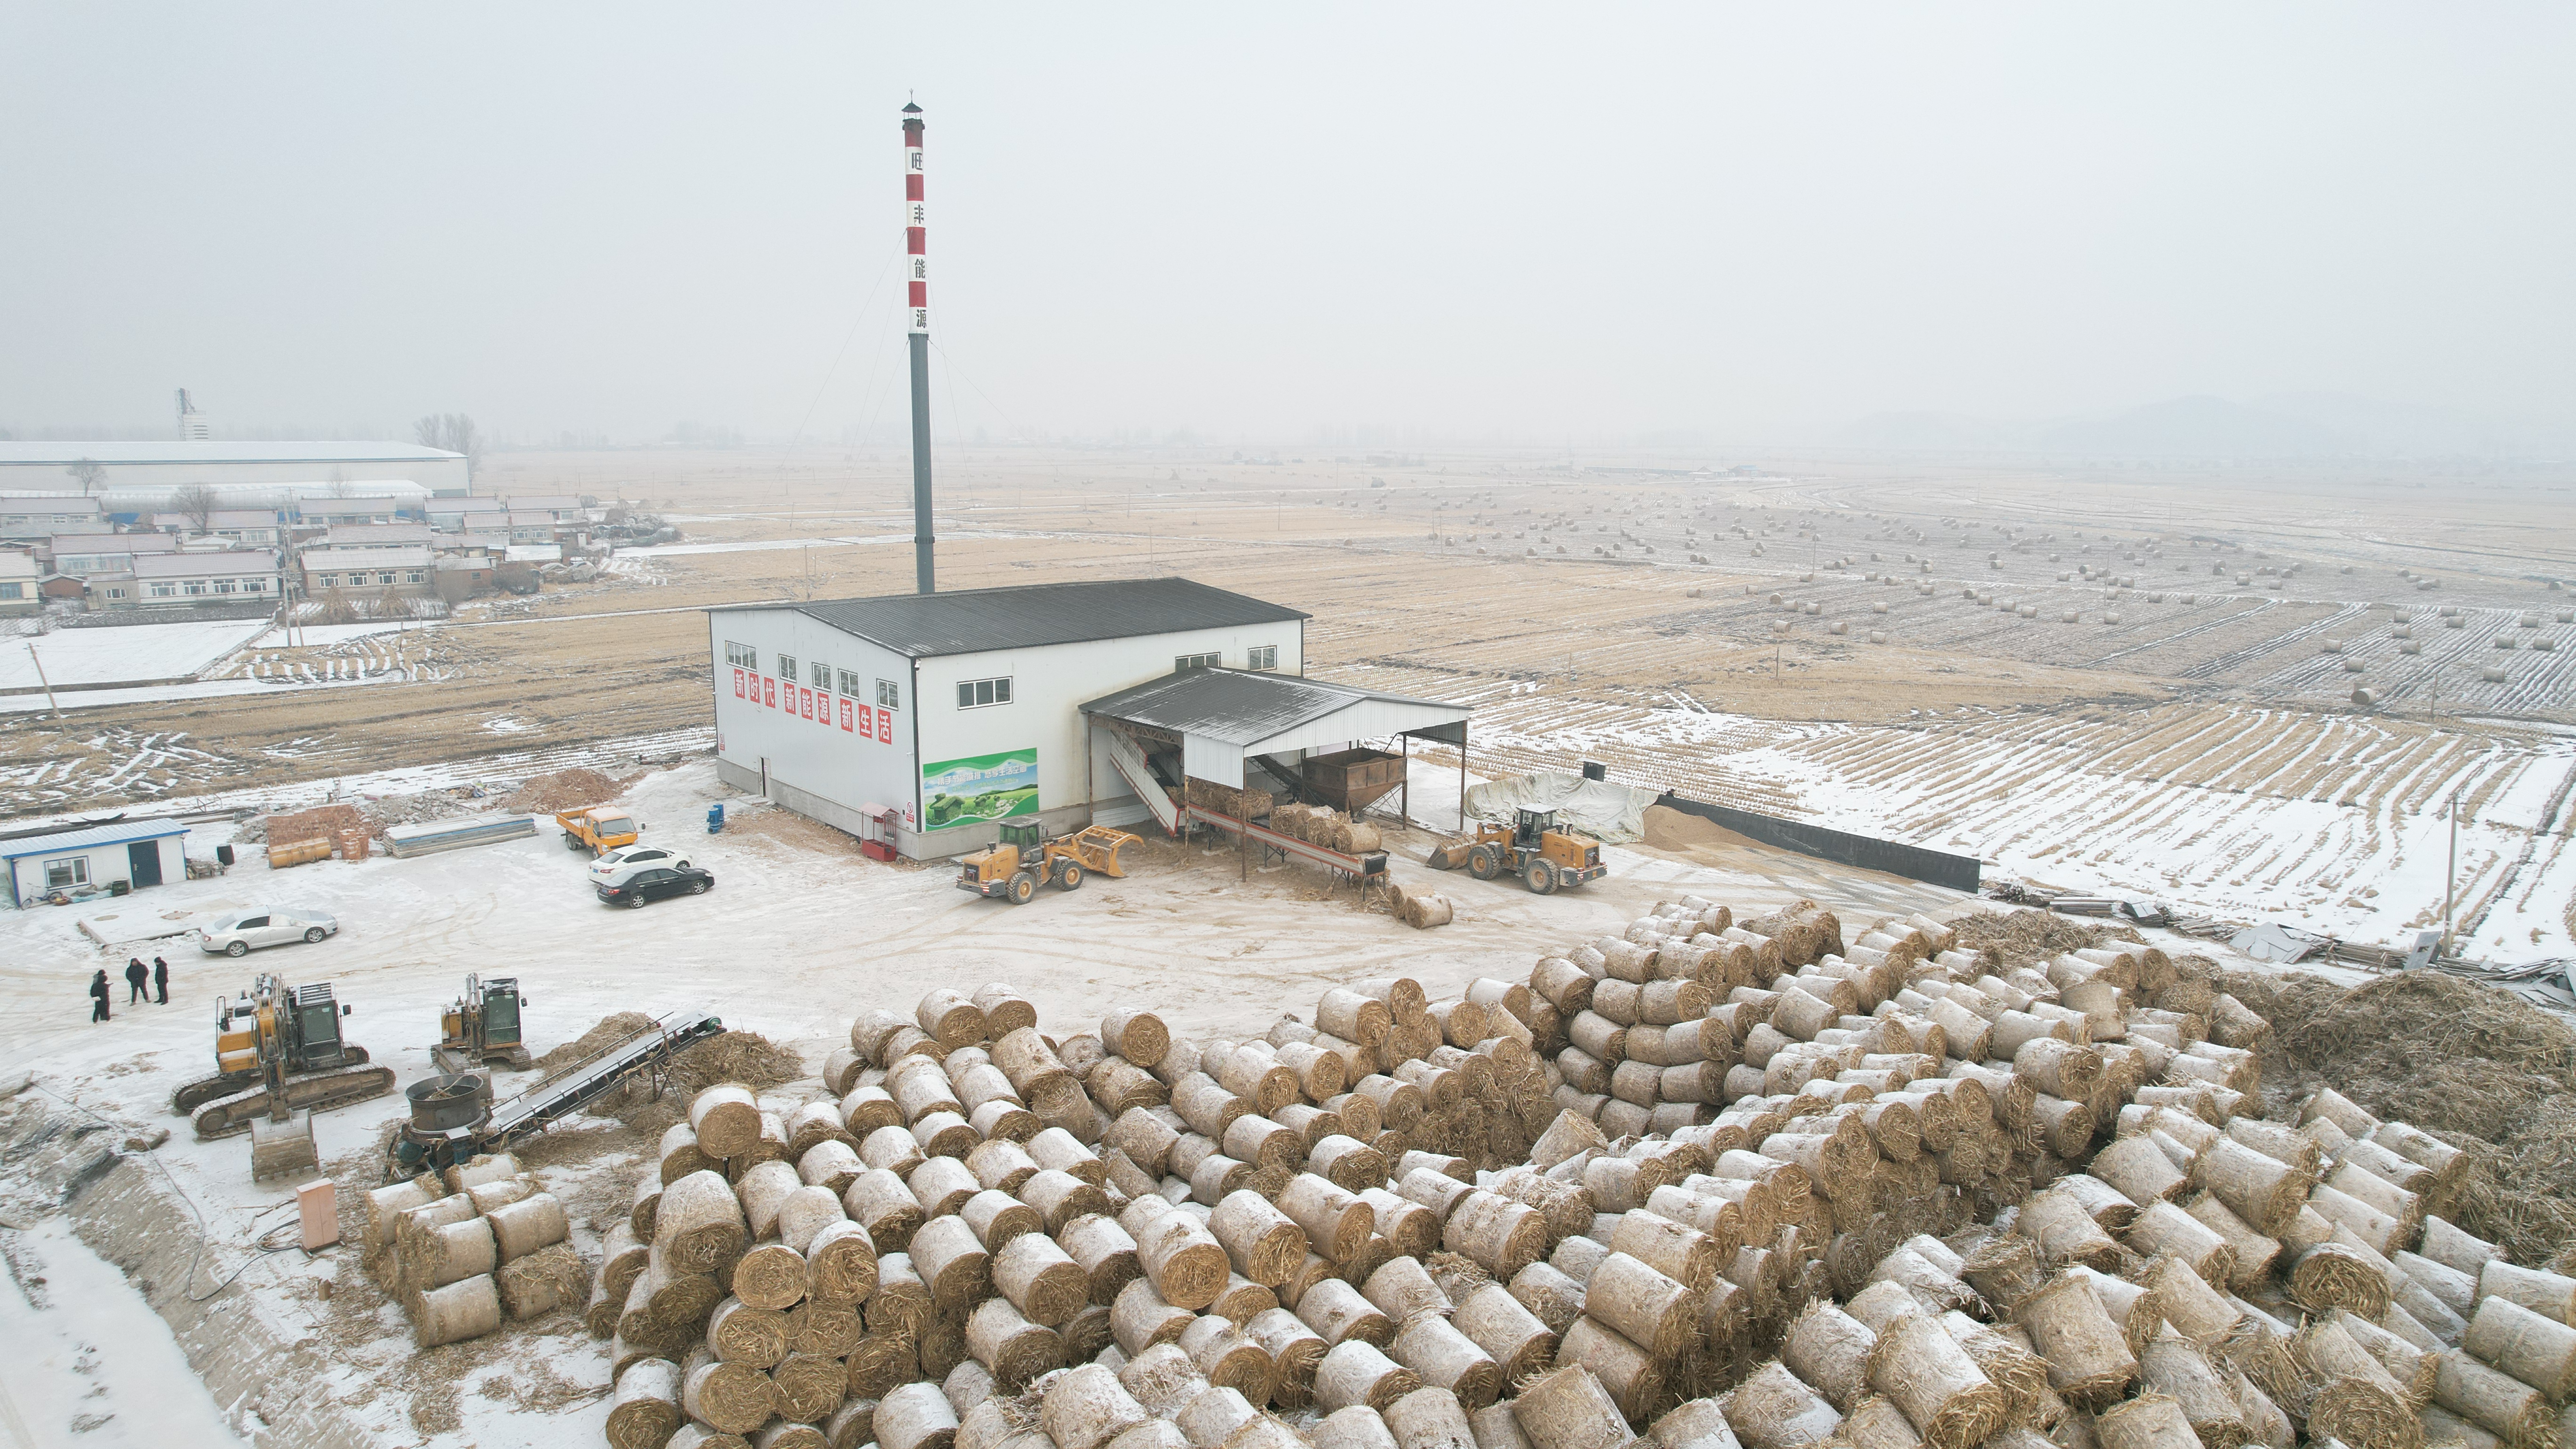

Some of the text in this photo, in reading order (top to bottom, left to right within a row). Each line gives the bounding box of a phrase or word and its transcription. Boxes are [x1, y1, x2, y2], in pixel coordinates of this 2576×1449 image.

[735, 672, 890, 741] 新时代 新能源 新生活
